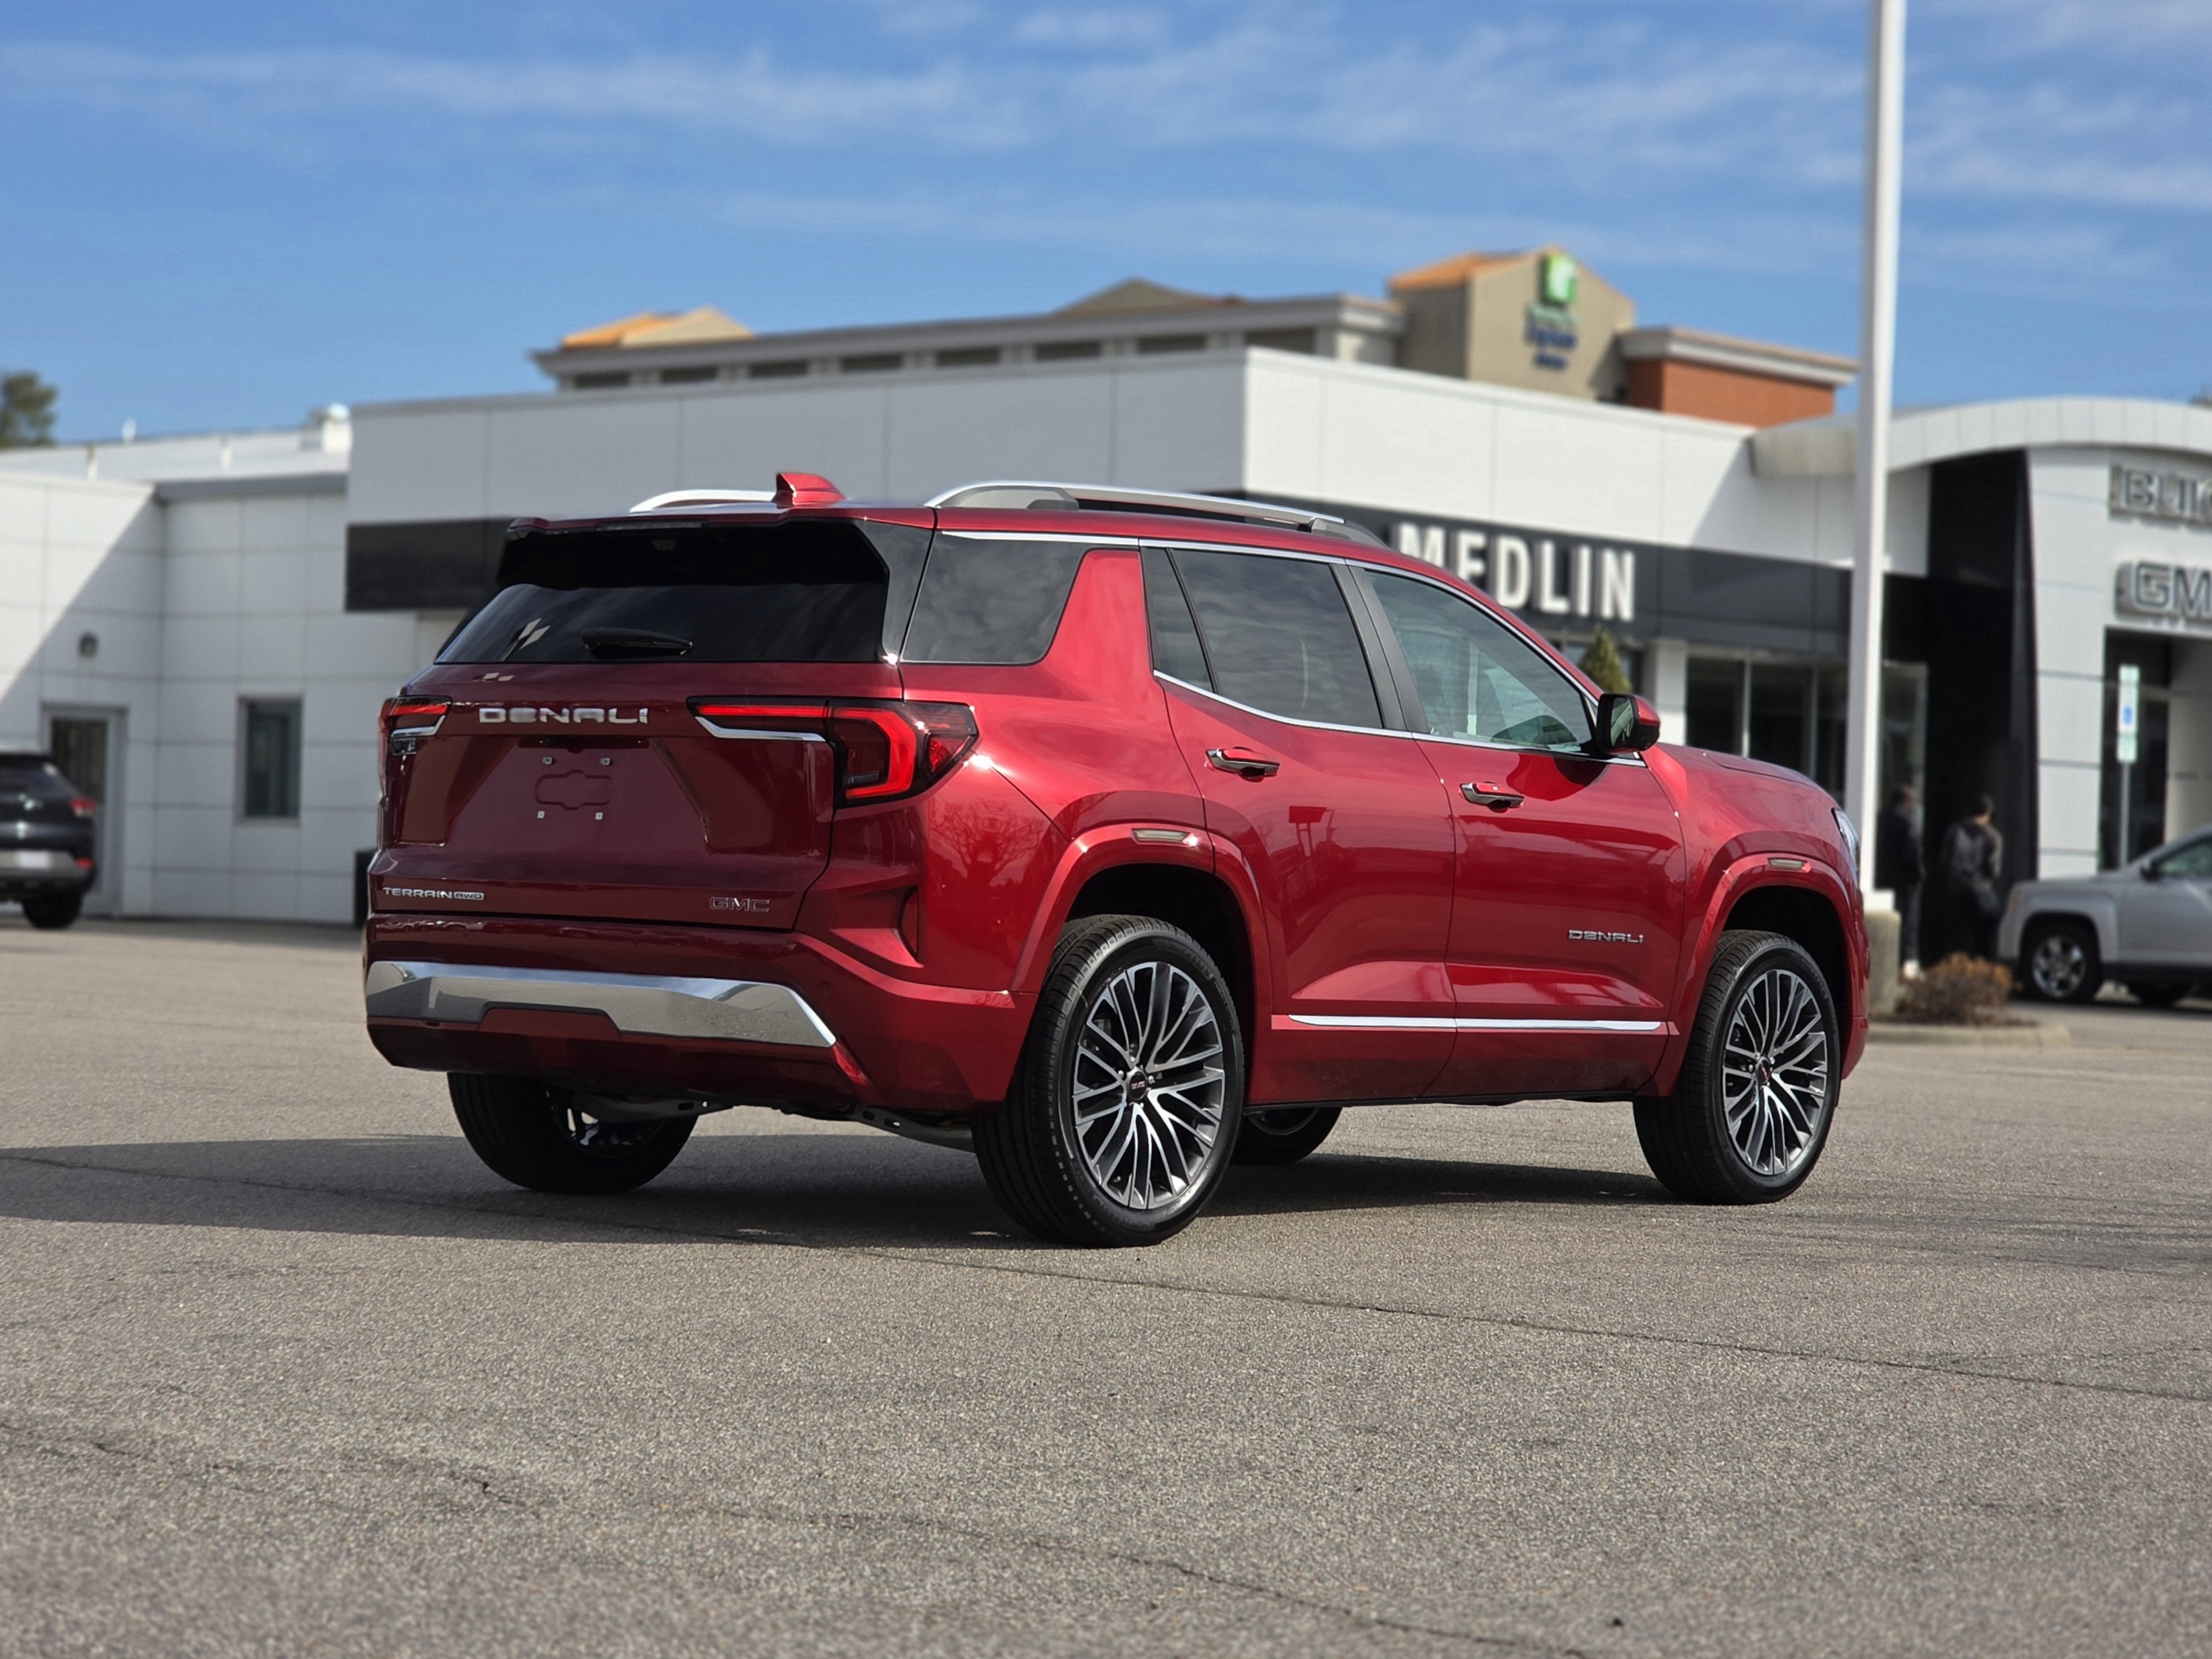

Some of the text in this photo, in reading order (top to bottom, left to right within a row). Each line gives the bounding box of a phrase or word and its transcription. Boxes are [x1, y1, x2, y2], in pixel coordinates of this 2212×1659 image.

[479, 707, 649, 724] DENALI
[382, 887, 485, 901] TERRAIN AWD
[709, 896, 771, 912] GMC
[1569, 929, 1644, 944] DENALI
